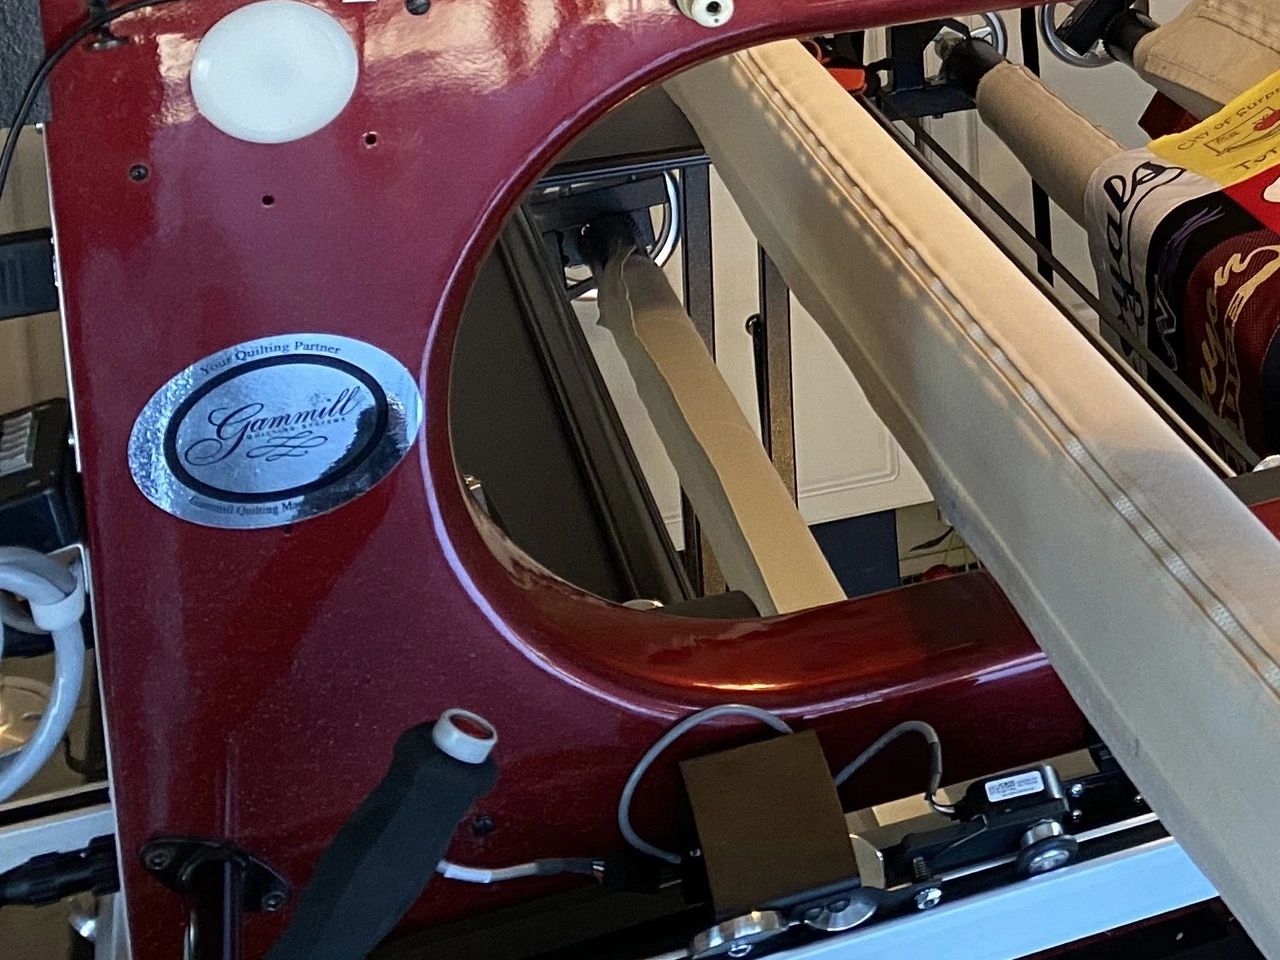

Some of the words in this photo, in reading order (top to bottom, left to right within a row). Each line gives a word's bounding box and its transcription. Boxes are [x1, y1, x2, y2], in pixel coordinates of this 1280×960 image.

[200, 353, 233, 376] Your
[234, 342, 290, 362] Quilting
[294, 340, 341, 356] Partner
[196, 386, 361, 455] Gammill
